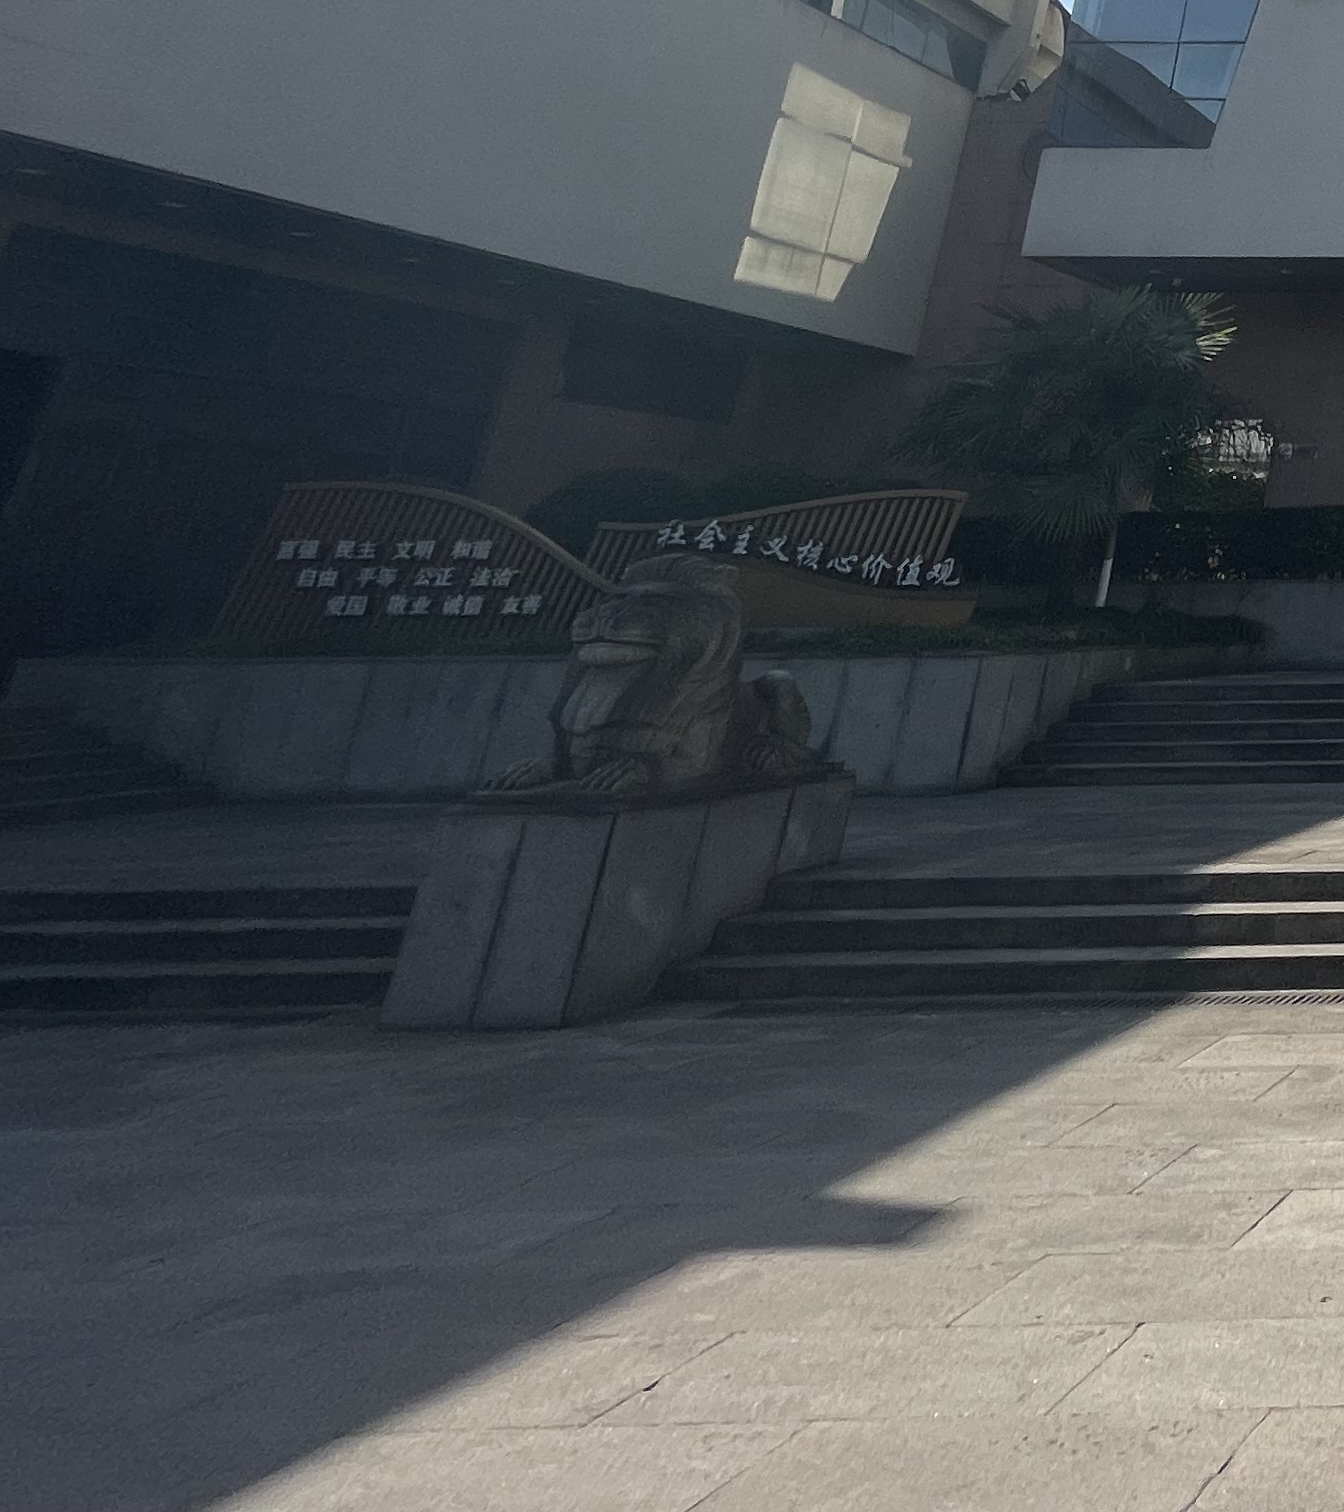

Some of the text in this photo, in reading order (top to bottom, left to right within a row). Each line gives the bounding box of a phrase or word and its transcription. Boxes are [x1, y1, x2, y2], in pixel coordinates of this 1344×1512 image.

[335, 540, 376, 560] 民主
[392, 540, 435, 560] 文明
[451, 539, 493, 560] 和谐
[656, 518, 960, 586] 社会主义核心价值观
[297, 567, 515, 588] 自由 平等 公正 法治
[325, 594, 542, 616] 爱国 敬业 诚信 友善
